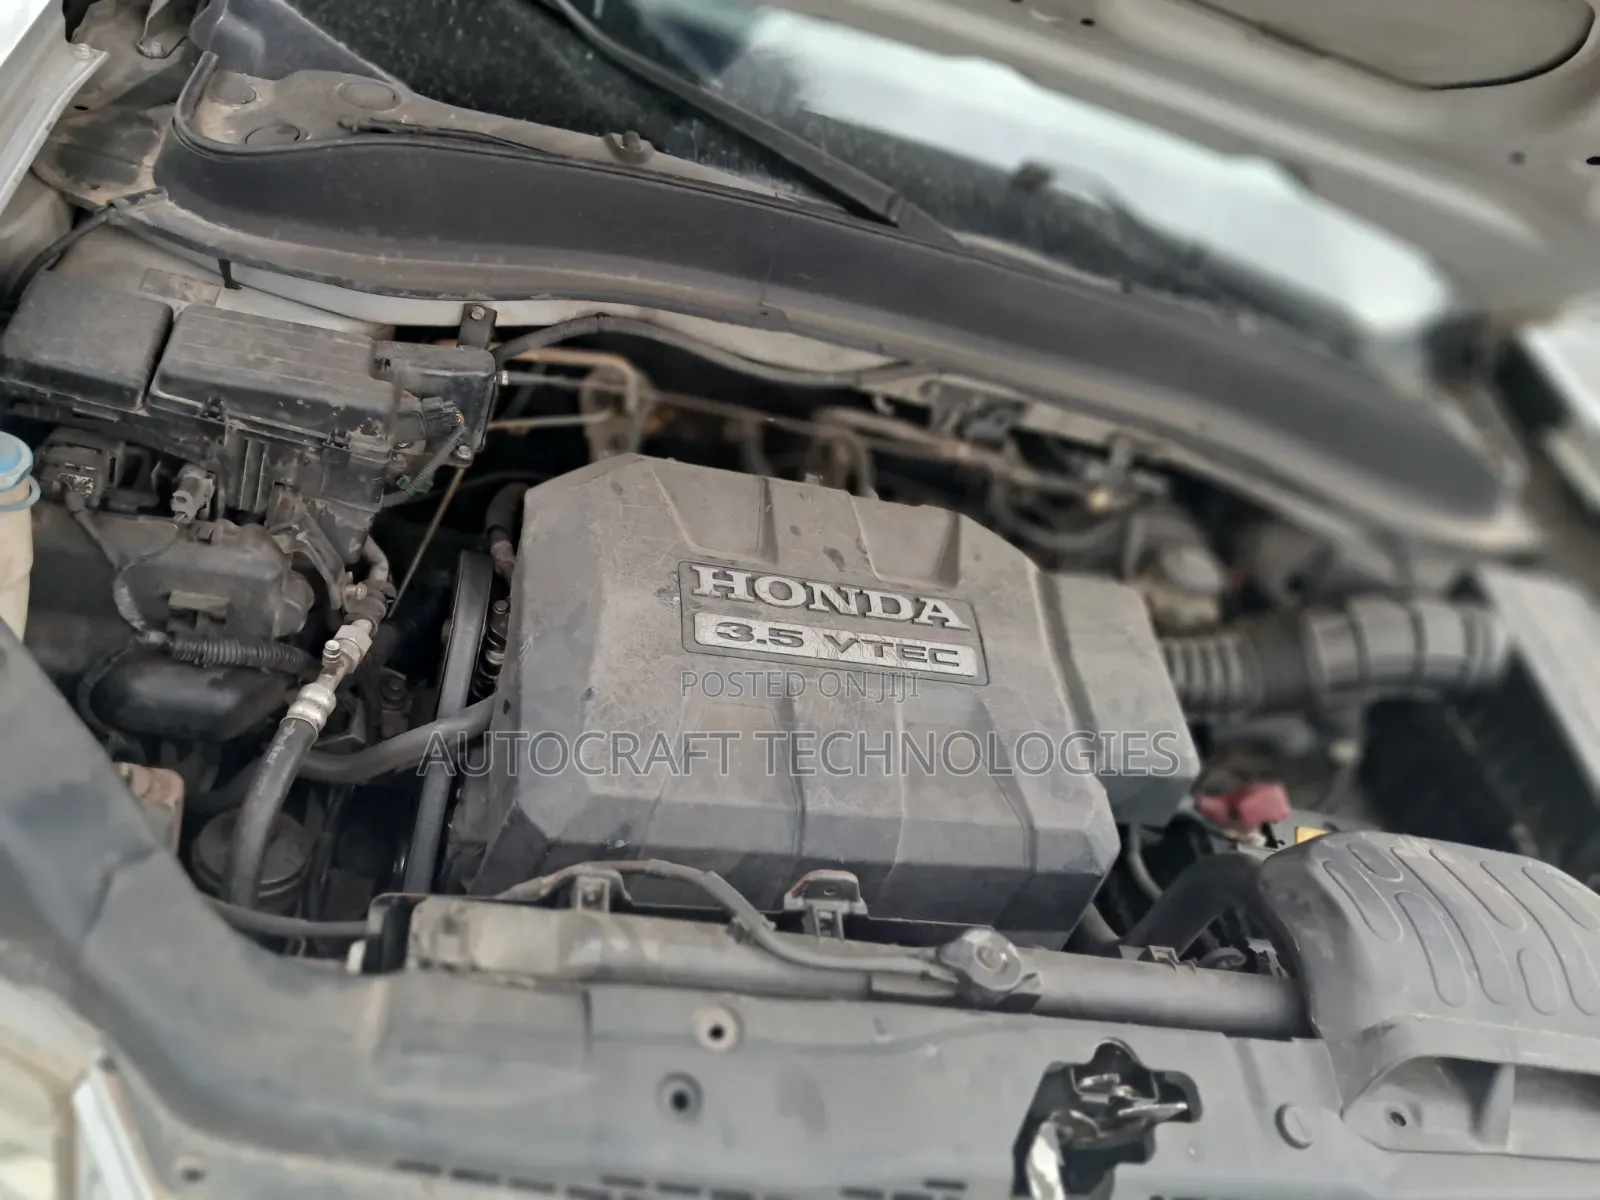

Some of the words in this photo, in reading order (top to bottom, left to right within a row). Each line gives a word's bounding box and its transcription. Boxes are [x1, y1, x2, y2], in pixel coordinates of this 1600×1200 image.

[691, 565, 970, 631] HONDA
[716, 621, 804, 648] 3.5
[823, 633, 960, 667] VTEC
